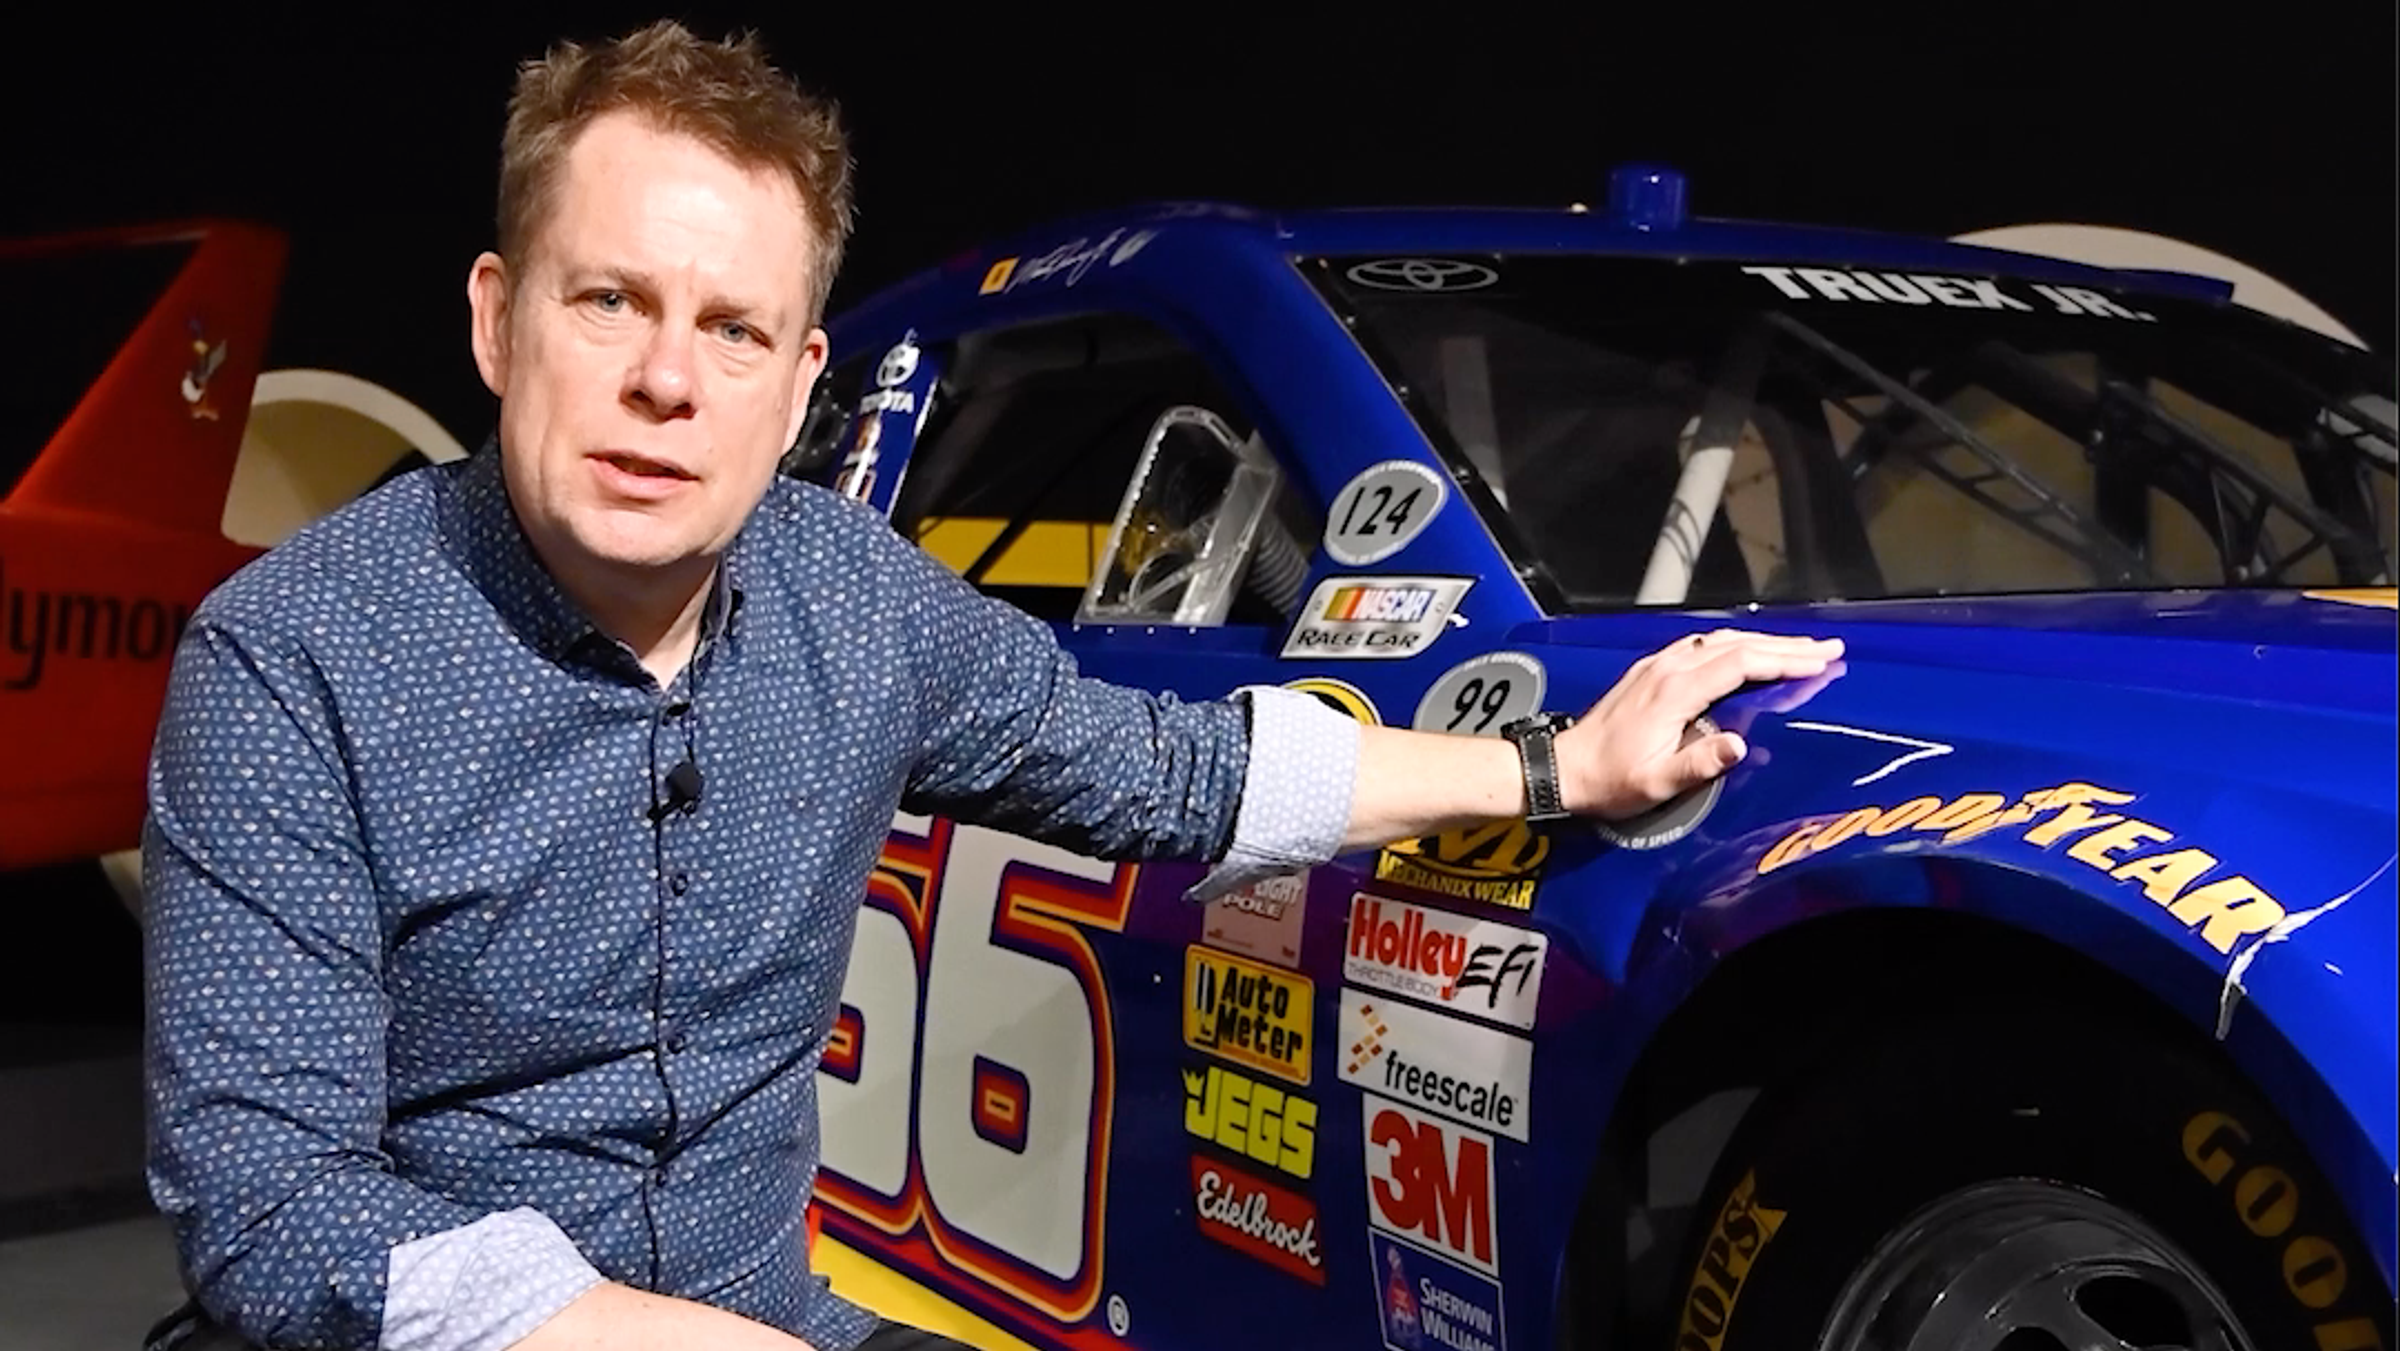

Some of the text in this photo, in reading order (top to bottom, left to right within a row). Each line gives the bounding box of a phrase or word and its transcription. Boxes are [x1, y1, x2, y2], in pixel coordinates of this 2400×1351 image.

[1741, 266, 2158, 322] TRUEX JR.
[1339, 485, 1422, 536] 124
[0, 554, 188, 690] ymo
[1353, 589, 1430, 622] NASCAR
[1297, 627, 1421, 648] RACE CAR
[1447, 678, 1510, 733] 99
[1375, 850, 1536, 910] MECHANIX WEAR
[1757, 780, 2287, 955] GOODYEAR
[1222, 893, 1285, 921] POLE
[1350, 897, 1468, 1001] Holley
[1220, 966, 1290, 1020] Auto
[1217, 1002, 1304, 1064] Meter
[1385, 1049, 1514, 1128] freescale
[1182, 1065, 1318, 1180] JEGS
[1196, 1170, 1321, 1267] Edelbrock
[1371, 1109, 1493, 1267] 3M
[2182, 1111, 2382, 1351] GOO
[1676, 1195, 1761, 1351] OPS
[1419, 1276, 1494, 1336] SHERWIN
[1420, 1305, 1496, 1351] WILLIA
